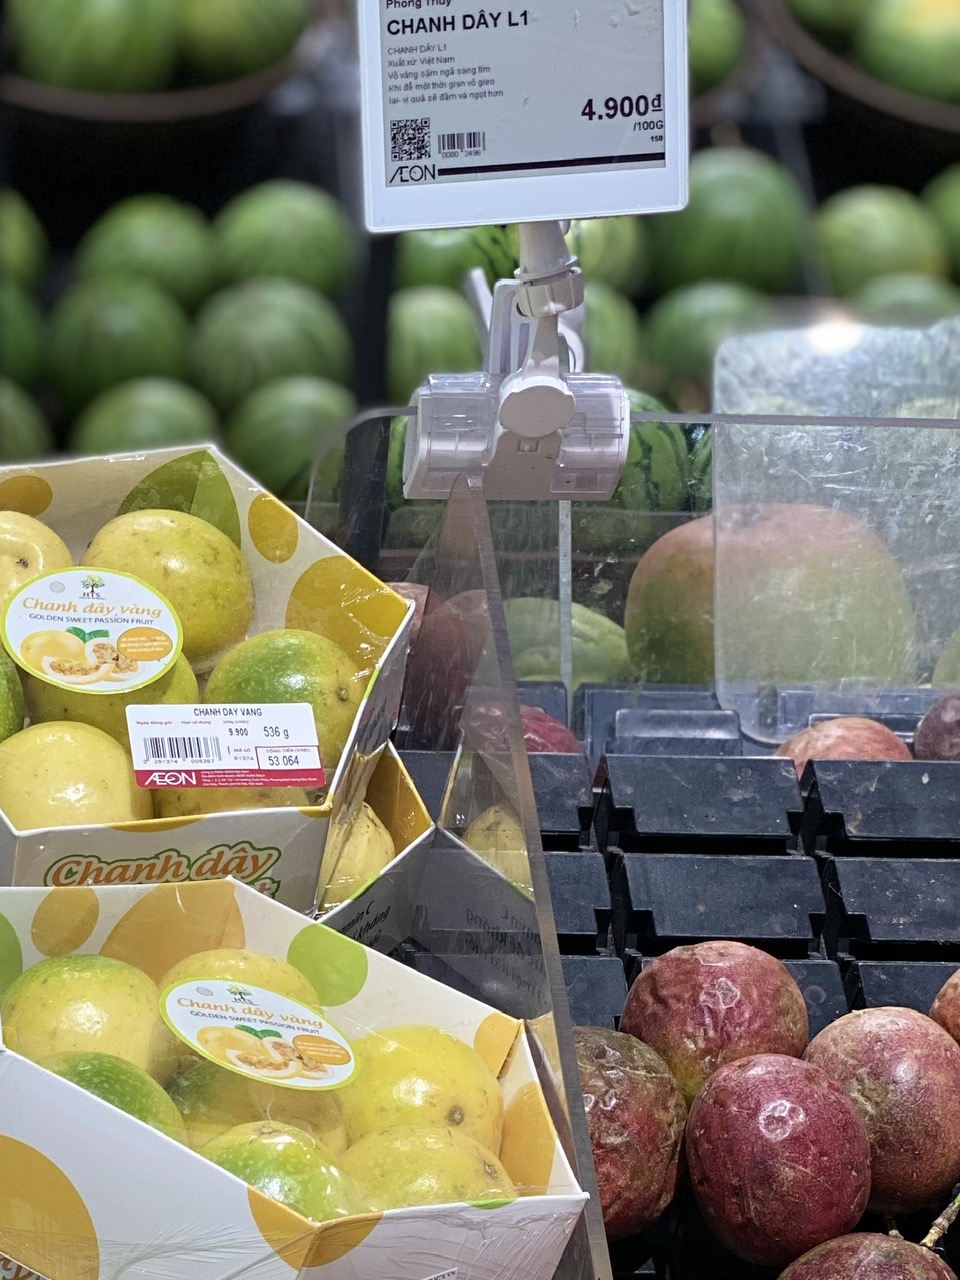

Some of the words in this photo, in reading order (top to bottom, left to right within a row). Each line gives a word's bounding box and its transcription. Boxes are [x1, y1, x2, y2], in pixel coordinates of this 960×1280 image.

[387, 16, 455, 35] CHANH
[463, 10, 501, 30] DÂY
[508, 10, 528, 27] L1
[633, 120, 663, 131] /100G
[22, 597, 77, 613] Chanh
[83, 603, 114, 616] dây
[120, 604, 162, 618] vàng
[223, 708, 238, 716] DAY
[240, 708, 262, 716] VANG
[229, 728, 248, 736] 9.900
[264, 727, 280, 737] 536
[283, 730, 289, 739] g
[269, 756, 299, 766] 53.064
[52, 851, 190, 886] Chanh
[195, 847, 273, 880] dây
